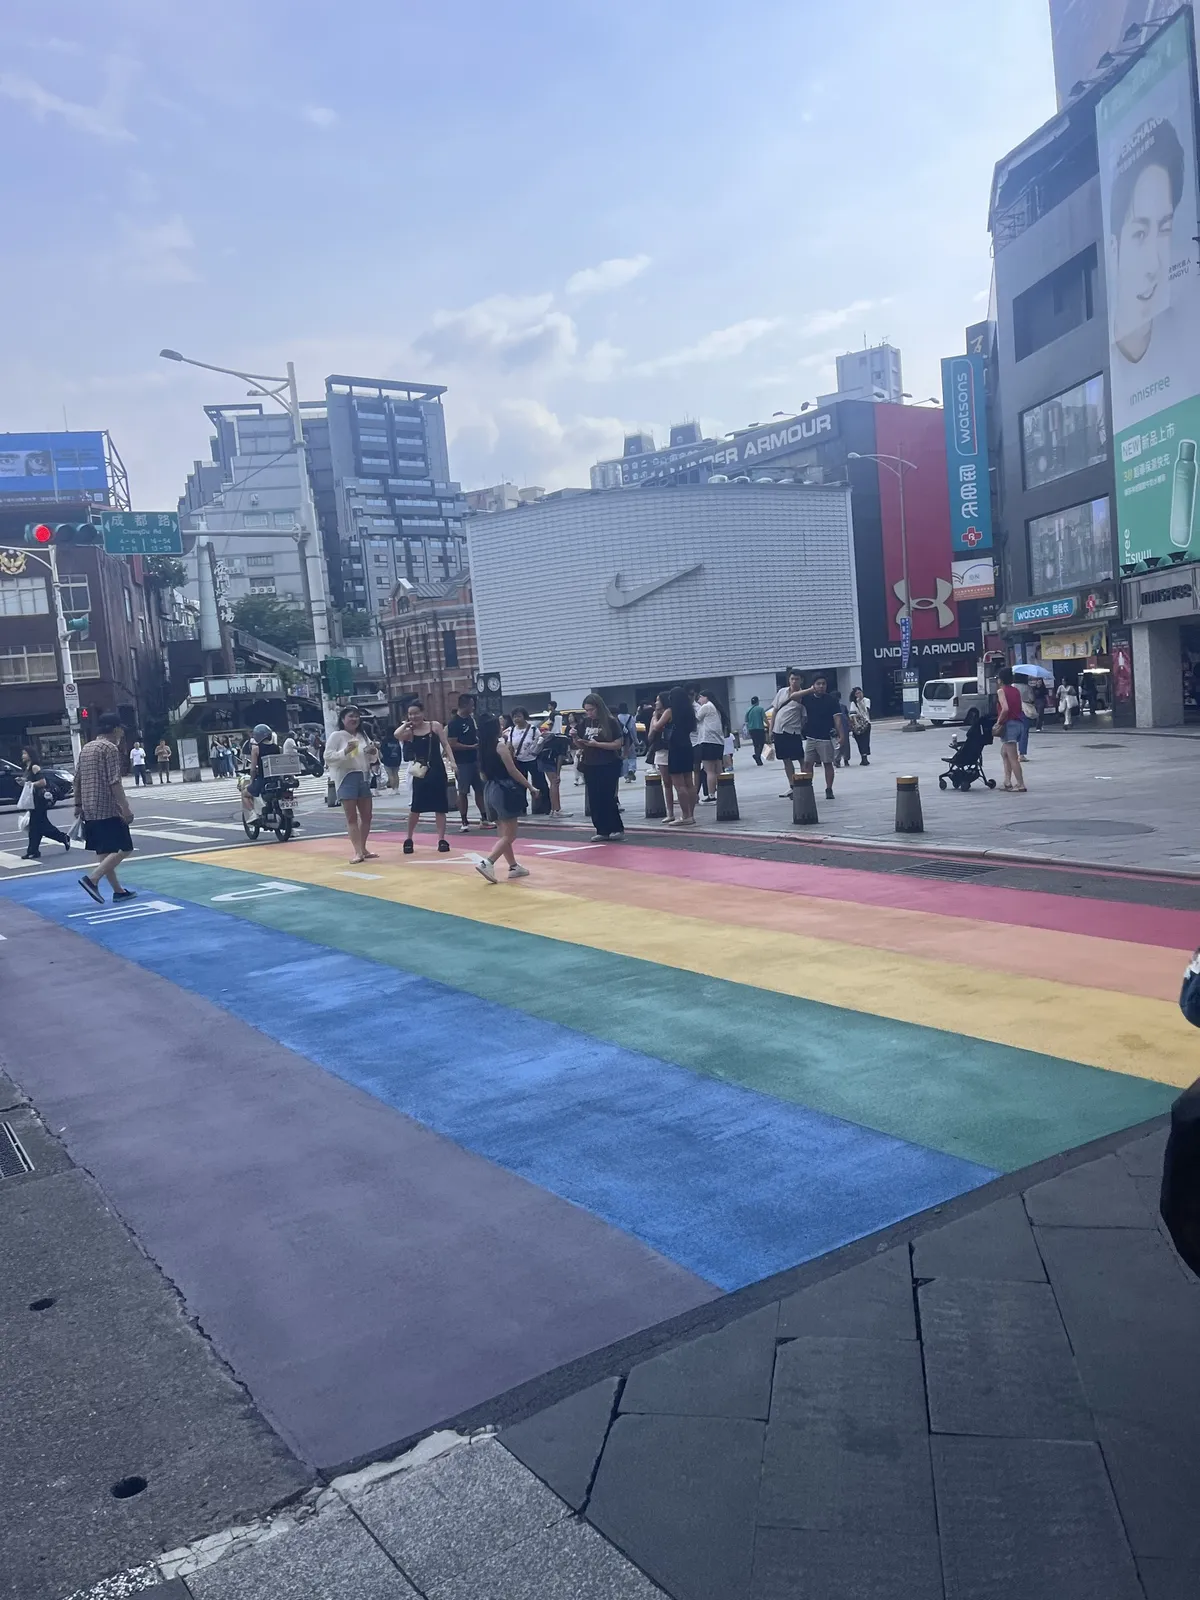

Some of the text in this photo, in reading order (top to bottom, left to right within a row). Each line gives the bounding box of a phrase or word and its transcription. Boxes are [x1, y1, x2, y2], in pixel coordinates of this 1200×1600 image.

[957, 371, 971, 444] watsons
[744, 413, 832, 458] ARMOUR
[1141, 423, 1175, 450] 新品上市
[1123, 438, 1139, 457] NEW
[111, 514, 171, 527] 成都路
[1017, 606, 1049, 620] watsons
[874, 641, 976, 659] UNDR ARMOUR
[0, 843, 607, 942] TAIPE
